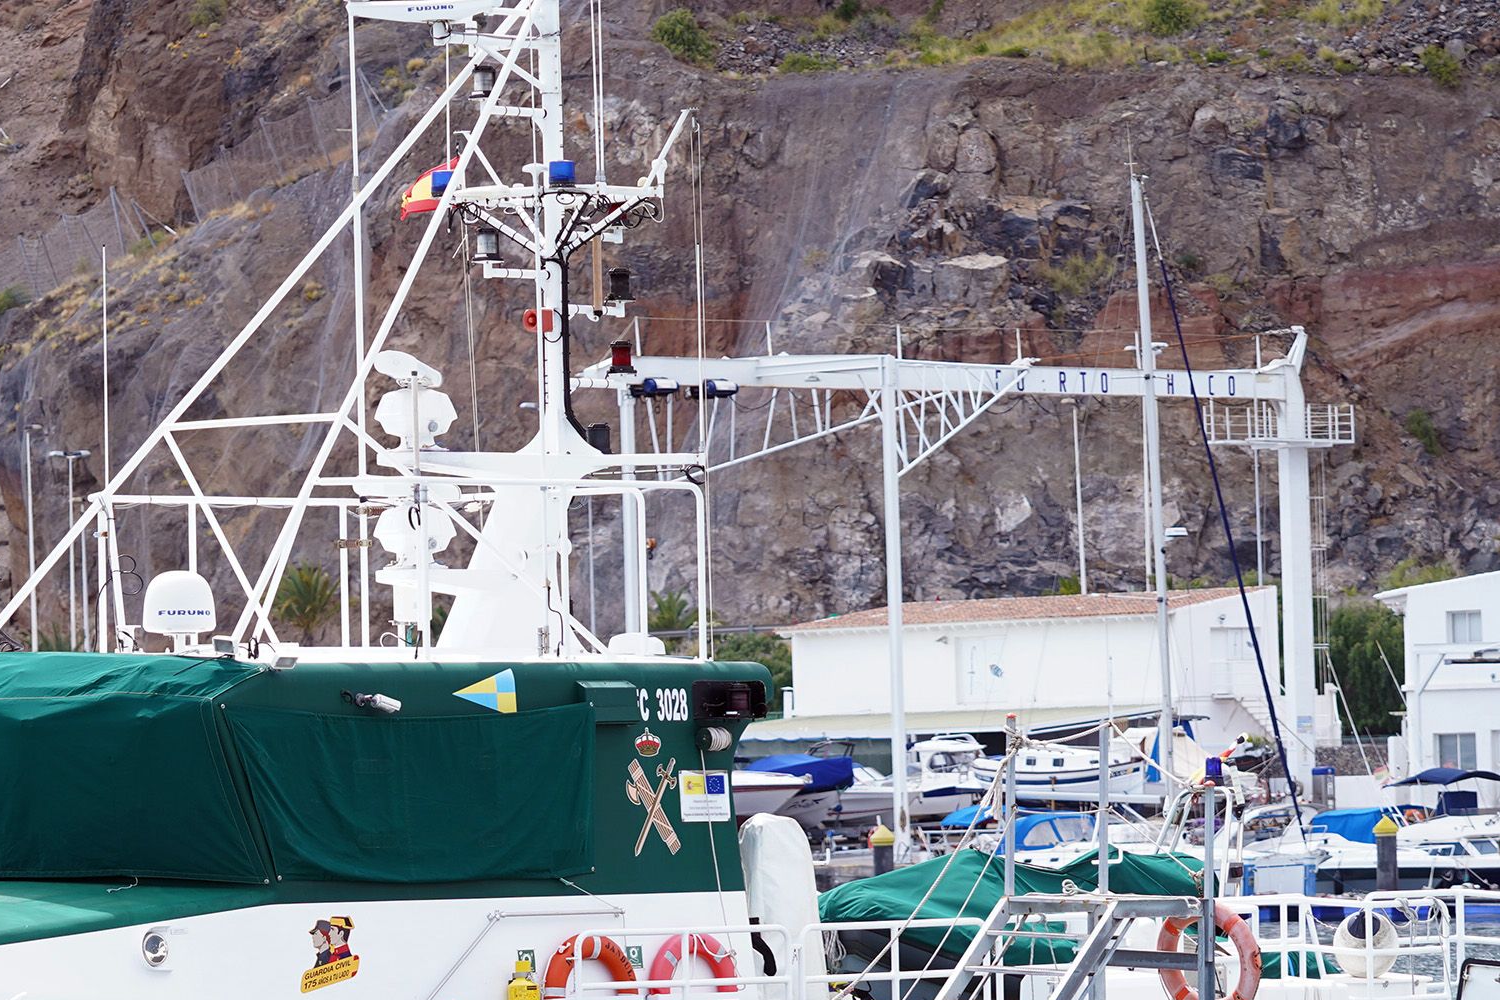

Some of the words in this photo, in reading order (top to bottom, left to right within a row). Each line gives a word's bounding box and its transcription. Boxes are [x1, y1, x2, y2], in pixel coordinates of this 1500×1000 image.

[995, 369, 1108, 394] URTO
[636, 688, 650, 722] C
[655, 688, 688, 722] 3028
[304, 966, 334, 980] GUARDIA
[335, 960, 351, 970] CIVIL
[304, 976, 317, 989] 175
